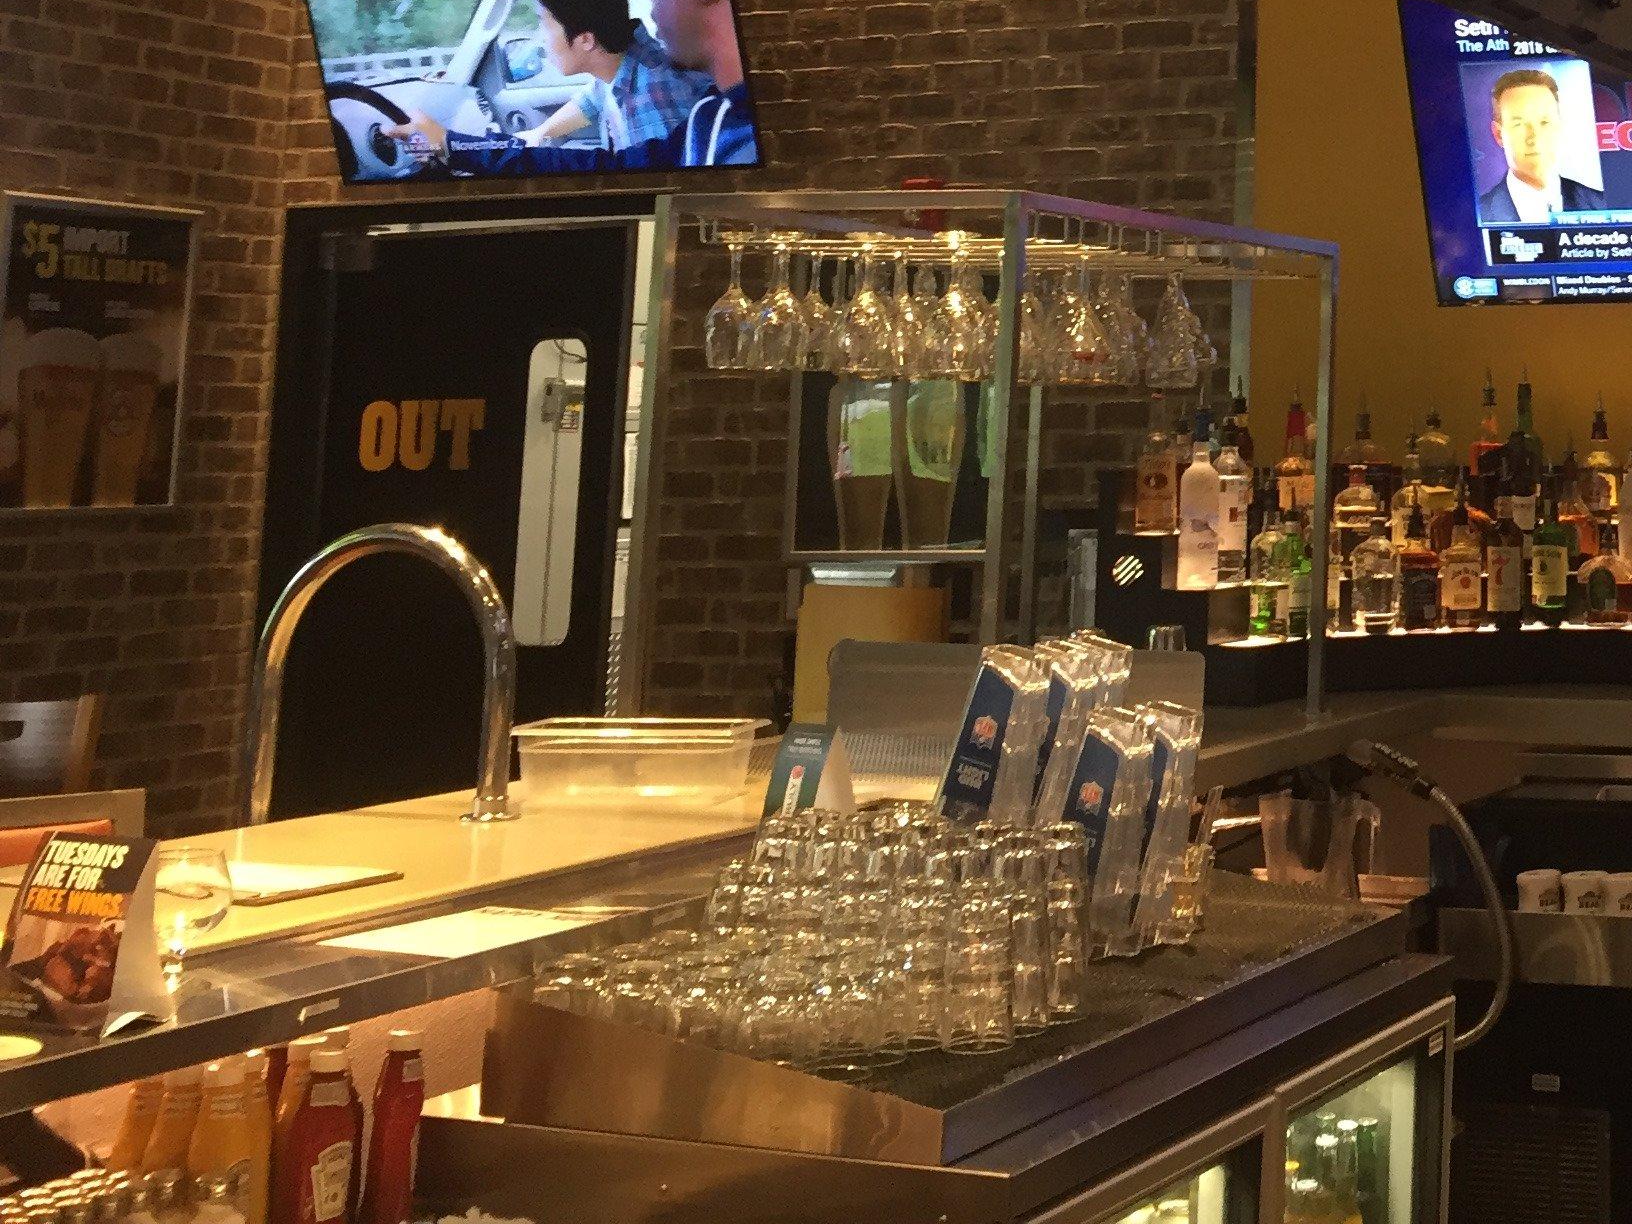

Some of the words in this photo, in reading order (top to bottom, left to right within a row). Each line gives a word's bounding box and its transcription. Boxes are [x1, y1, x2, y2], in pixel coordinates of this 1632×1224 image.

[1456, 39, 1485, 53] The
[23, 219, 61, 279] $5
[1558, 232, 1572, 246] A
[1573, 231, 1628, 246] decade
[1560, 249, 1594, 259] Article
[1596, 248, 1609, 260] by
[358, 397, 486, 472] OUT
[44, 840, 130, 869] TUESDAYS
[31, 863, 71, 889] ARE
[65, 866, 104, 892] FOR
[22, 887, 69, 914] FREE
